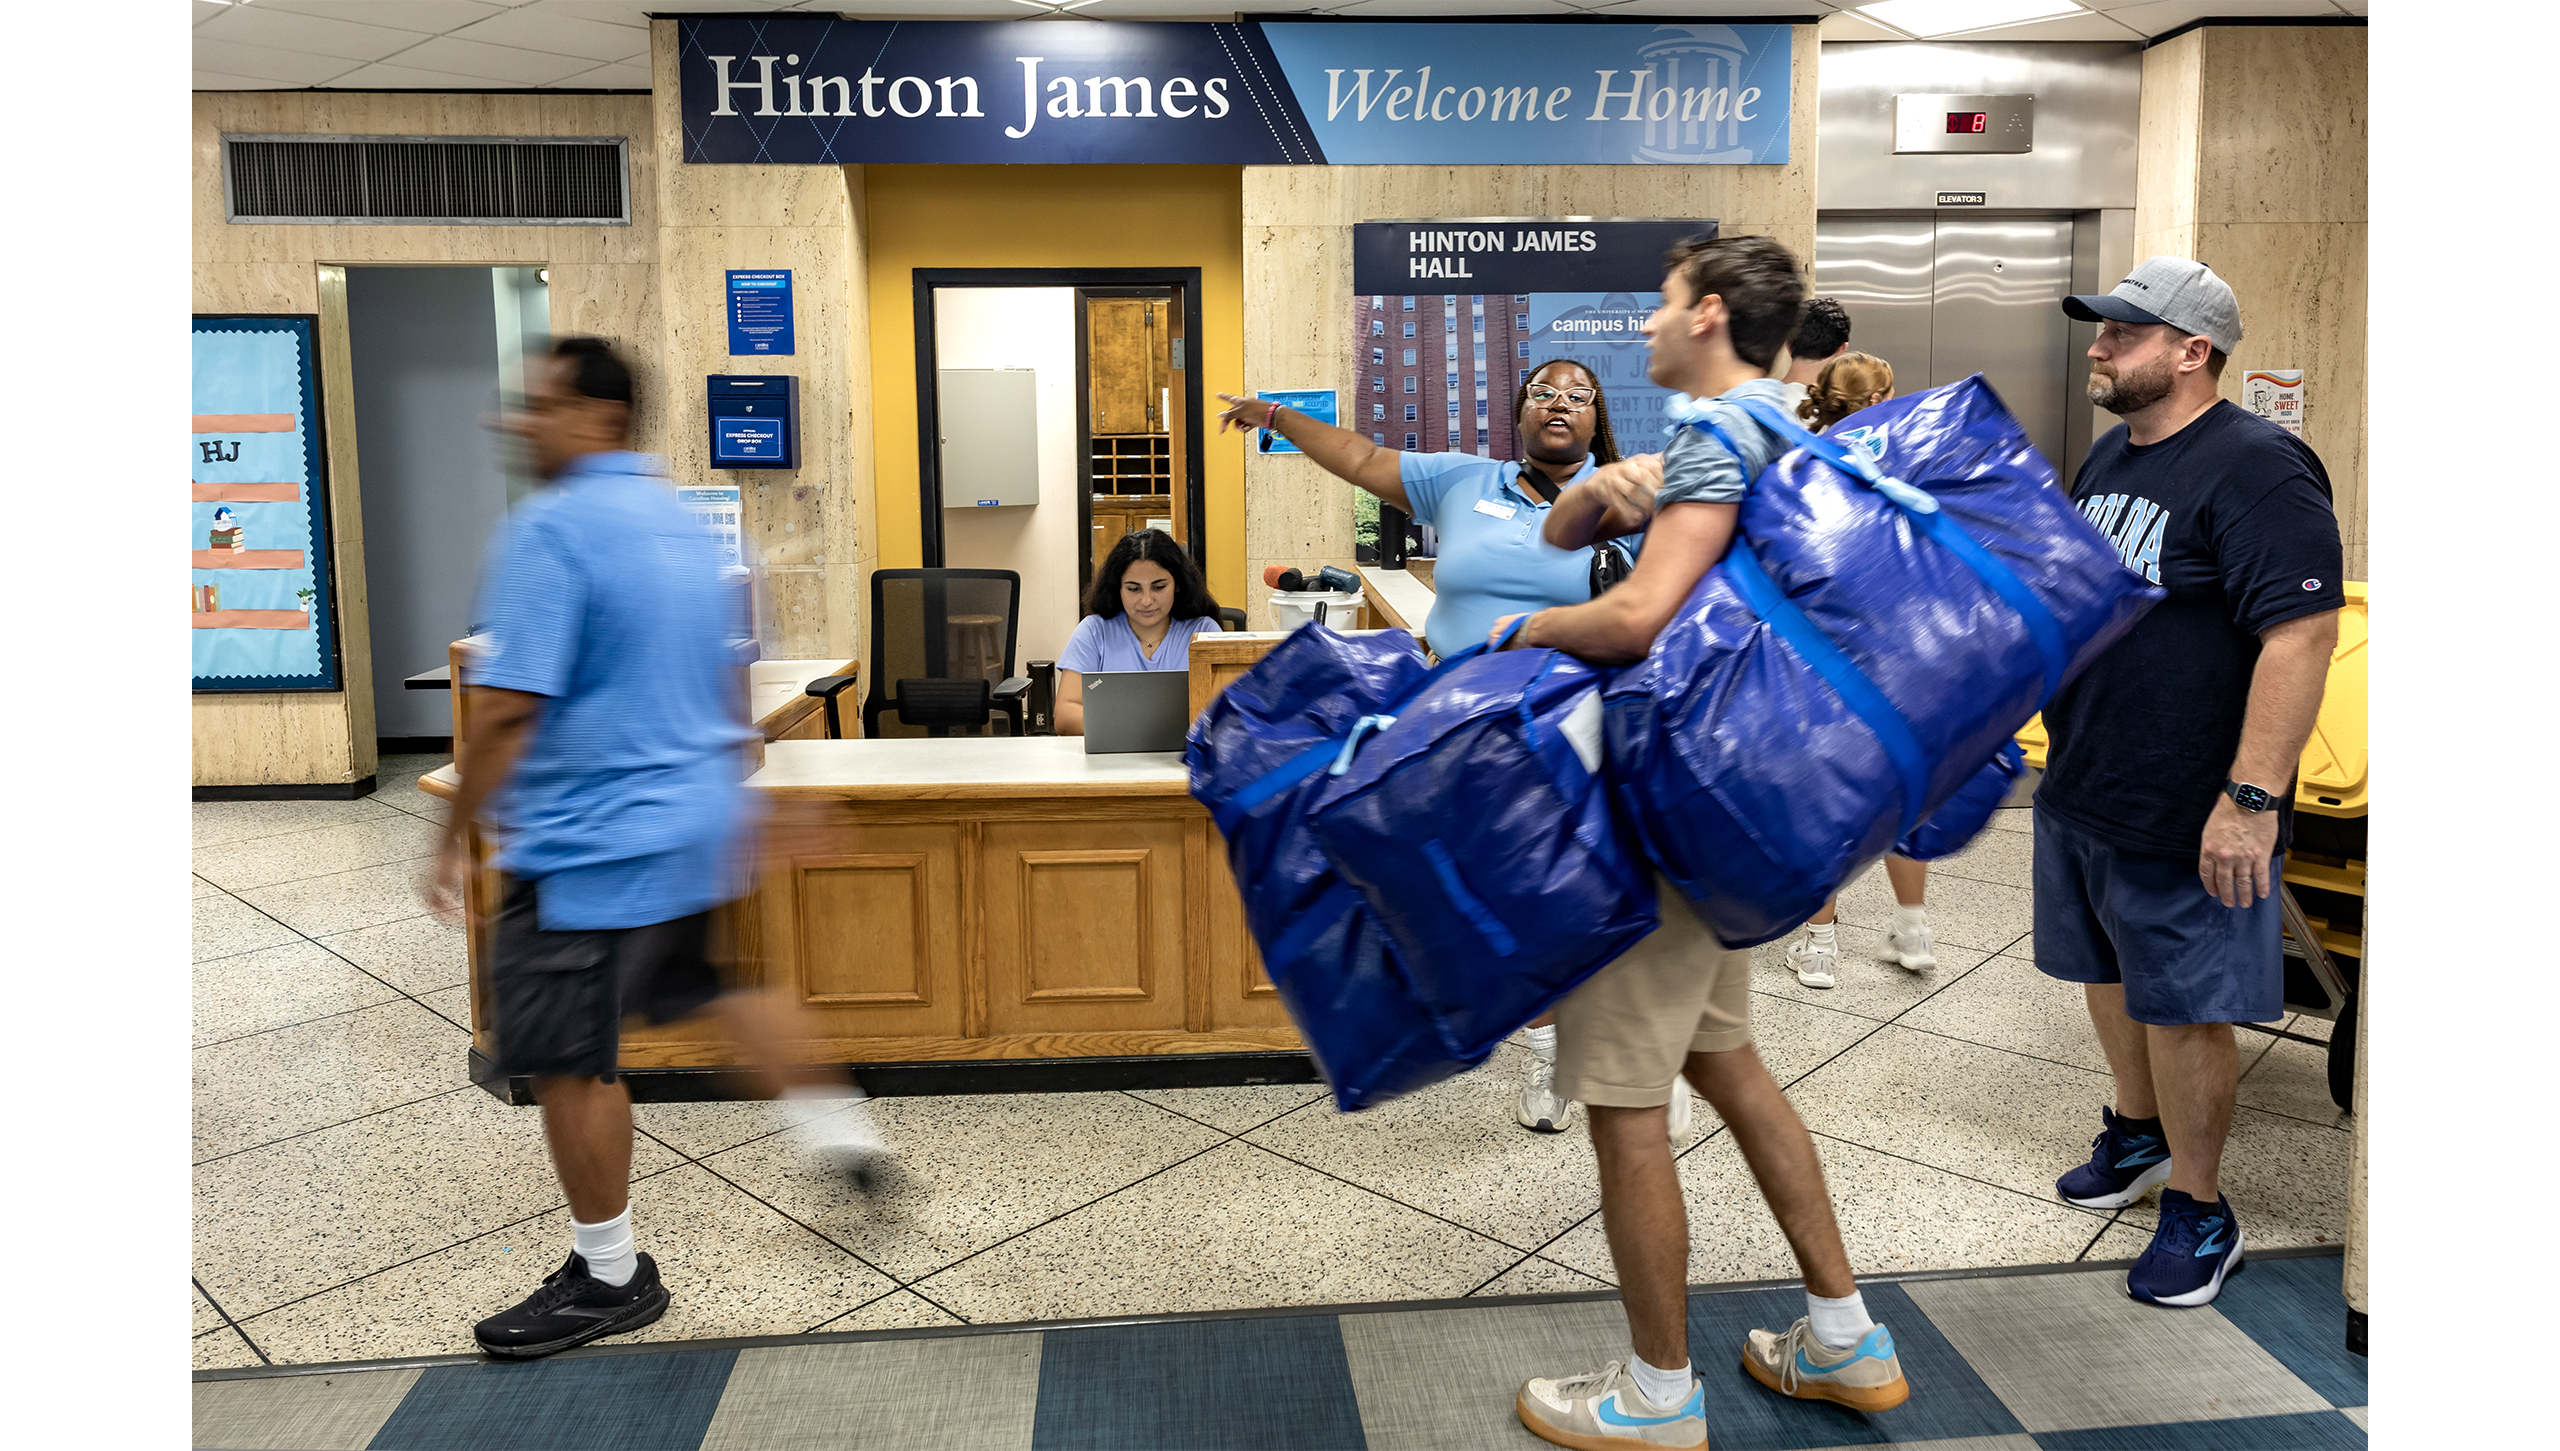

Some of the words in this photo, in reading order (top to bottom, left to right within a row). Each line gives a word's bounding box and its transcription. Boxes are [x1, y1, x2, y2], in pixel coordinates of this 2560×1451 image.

[708, 53, 985, 119] Hinton
[1004, 56, 1231, 139] James
[1324, 66, 1573, 122] Welcome
[1586, 70, 1762, 122] Home
[1971, 113, 1986, 133] 8
[1409, 230, 1505, 252] HINTON
[1512, 230, 1597, 252] JAMES
[1409, 257, 1473, 279] HALL
[1552, 319, 1624, 335] campus
[2274, 400, 2299, 410] SWEET
[2279, 392, 2294, 400] HOME
[199, 440, 241, 463] HJ
